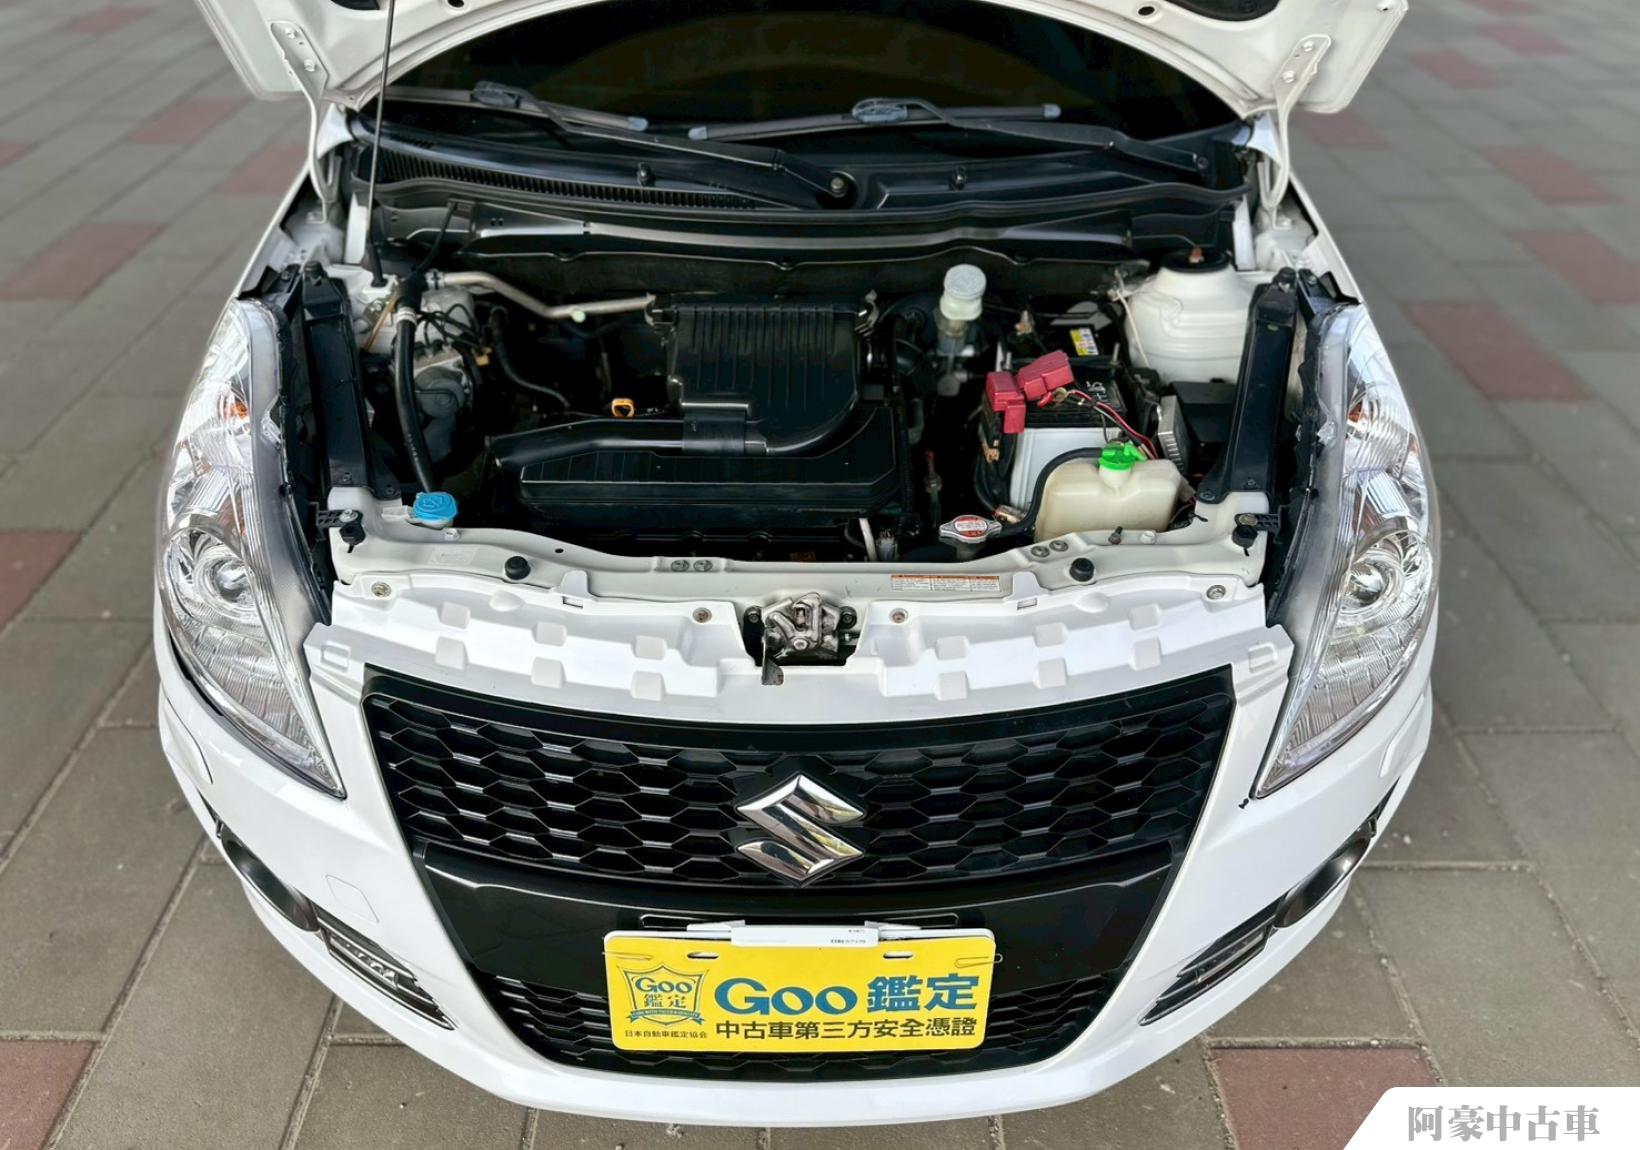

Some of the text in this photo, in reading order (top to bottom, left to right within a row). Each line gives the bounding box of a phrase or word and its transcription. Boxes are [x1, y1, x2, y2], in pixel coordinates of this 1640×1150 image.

[635, 977, 692, 993] Goo
[714, 973, 979, 1015] Goo 鑑定
[643, 993, 687, 1008] 鑑定
[715, 1017, 977, 1040] 中古車第三方安全憑證
